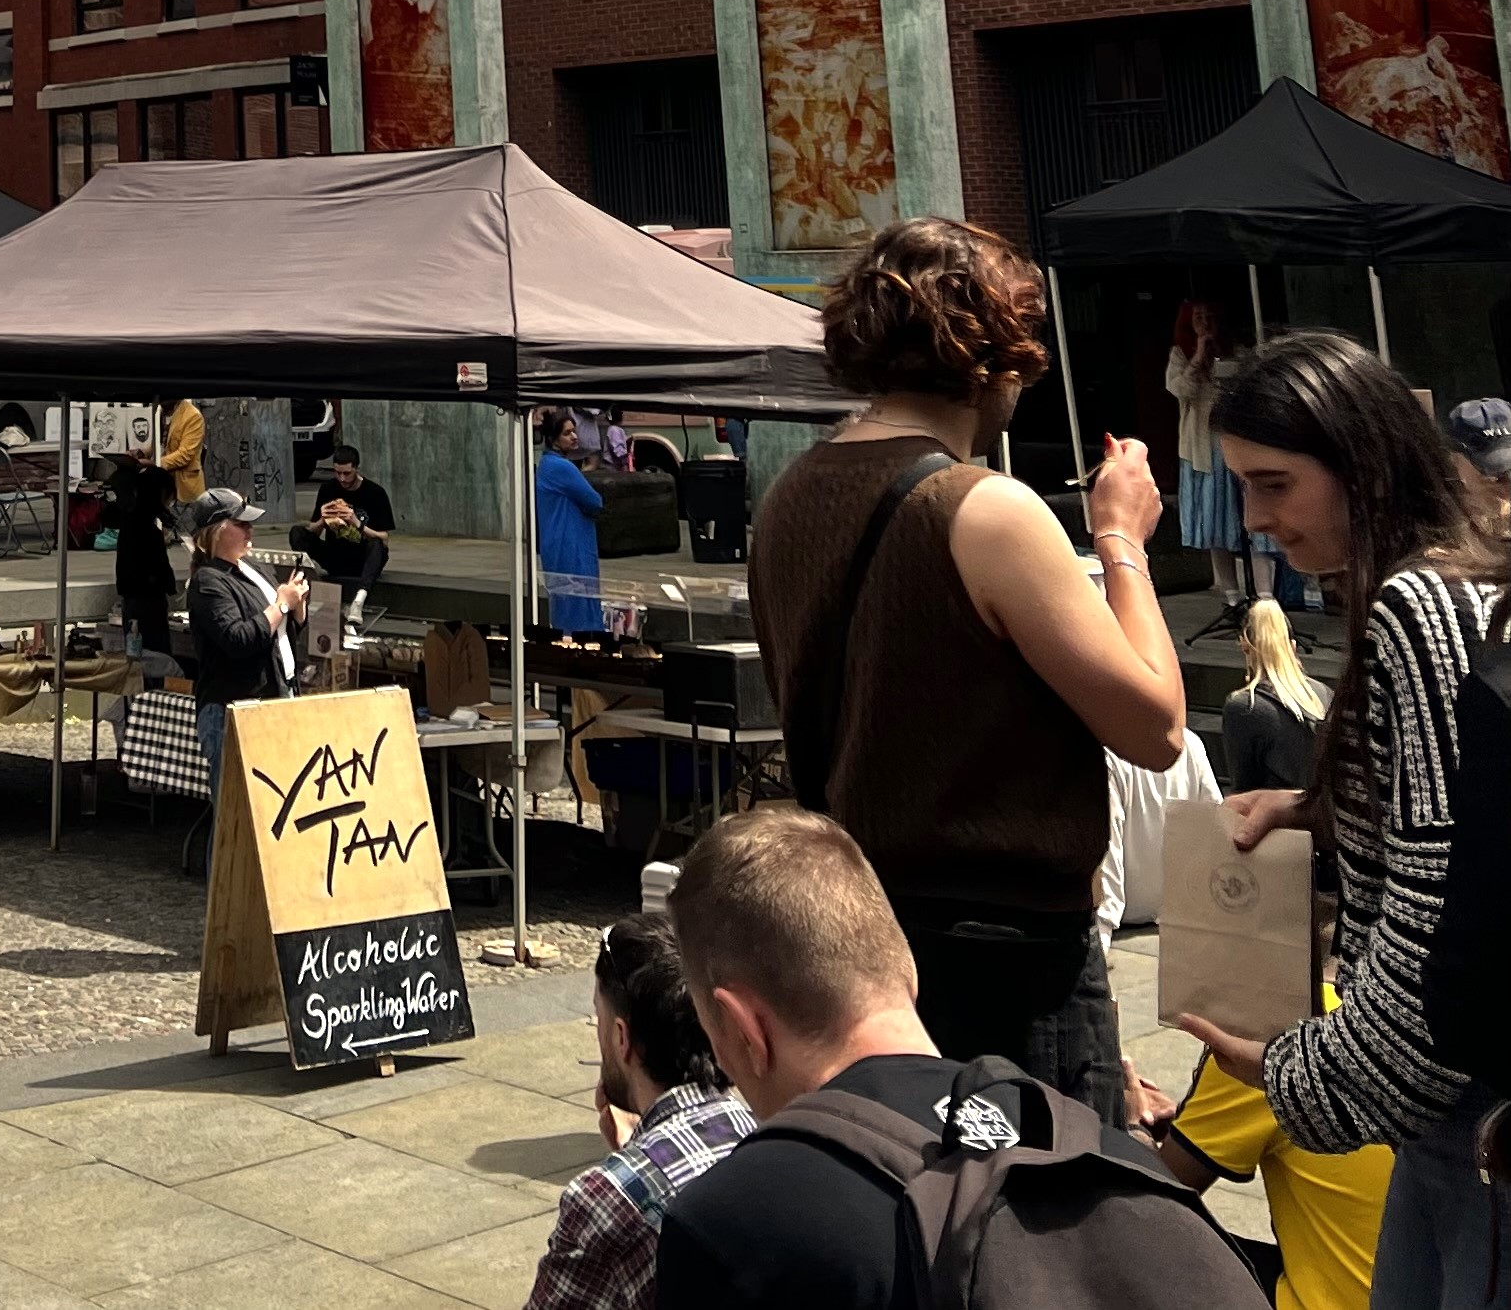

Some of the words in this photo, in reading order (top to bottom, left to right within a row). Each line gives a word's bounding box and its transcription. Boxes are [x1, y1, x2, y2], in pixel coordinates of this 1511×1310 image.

[252, 727, 388, 841] YAN
[294, 800, 428, 898] TAN
[296, 926, 442, 985] Alcoholic
